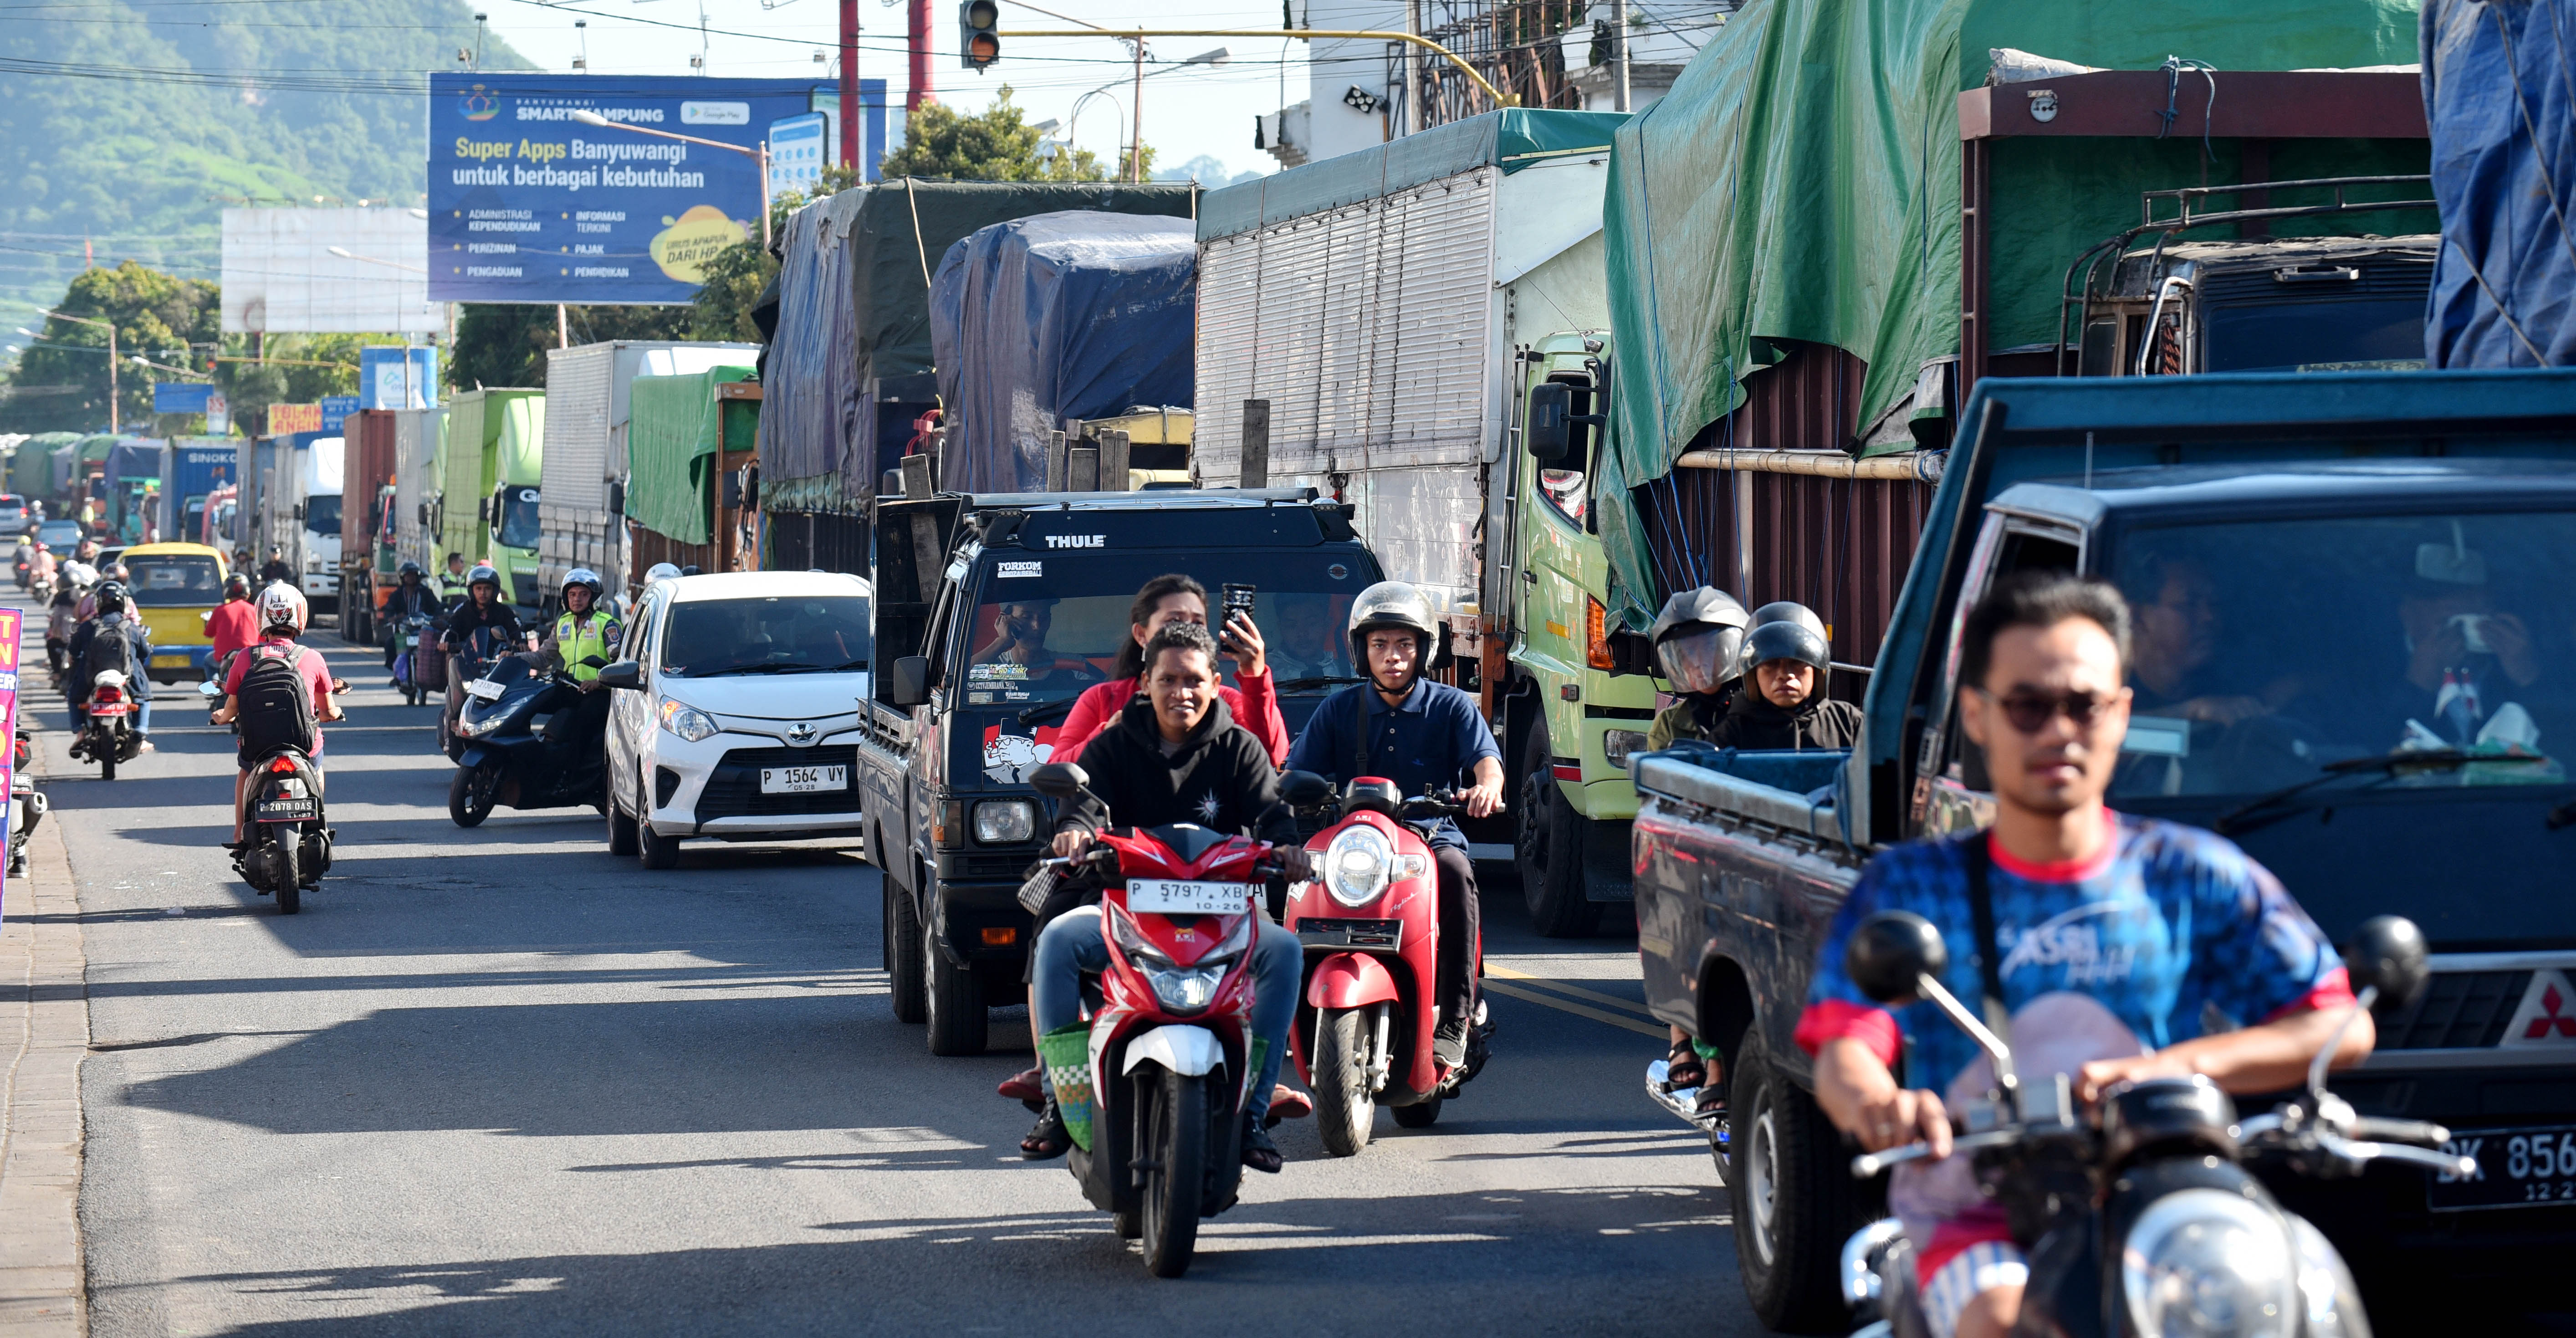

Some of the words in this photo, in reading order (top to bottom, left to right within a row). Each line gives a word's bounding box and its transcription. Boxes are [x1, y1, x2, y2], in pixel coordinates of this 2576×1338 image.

[516, 107, 575, 121] SMART
[581, 108, 664, 122] AMPUNG
[455, 137, 513, 162] Super
[517, 138, 566, 163] Apps
[572, 139, 687, 165] Banyuwangi
[453, 164, 509, 186] untuk
[514, 164, 597, 191] berbagai
[603, 165, 704, 188] kebutuhan
[469, 210, 532, 220] ADMINISTRASI
[576, 211, 625, 221] INFORMASI
[469, 221, 541, 232] KEPENDUDUKAN
[577, 223, 611, 233] TERKINI
[468, 243, 516, 254] PERIZINAN
[575, 244, 604, 255] PAJAK
[667, 247, 697, 264] DARI
[700, 246, 719, 257] HP
[467, 267, 522, 277] PENGADUAN
[575, 267, 629, 277] PENDIDIKAN
[1046, 535, 1104, 548] THULE
[998, 561, 1041, 571] FORKOM
[764, 771, 771, 784] P
[785, 769, 818, 784] 1564
[828, 767, 843, 781] VY
[260, 803, 265, 812] P
[270, 802, 291, 811] 2078
[1133, 882, 1140, 895] P
[1161, 884, 1201, 897] 5797
[1222, 886, 1242, 898] XB
[2525, 1181, 2576, 1201] 12-2
